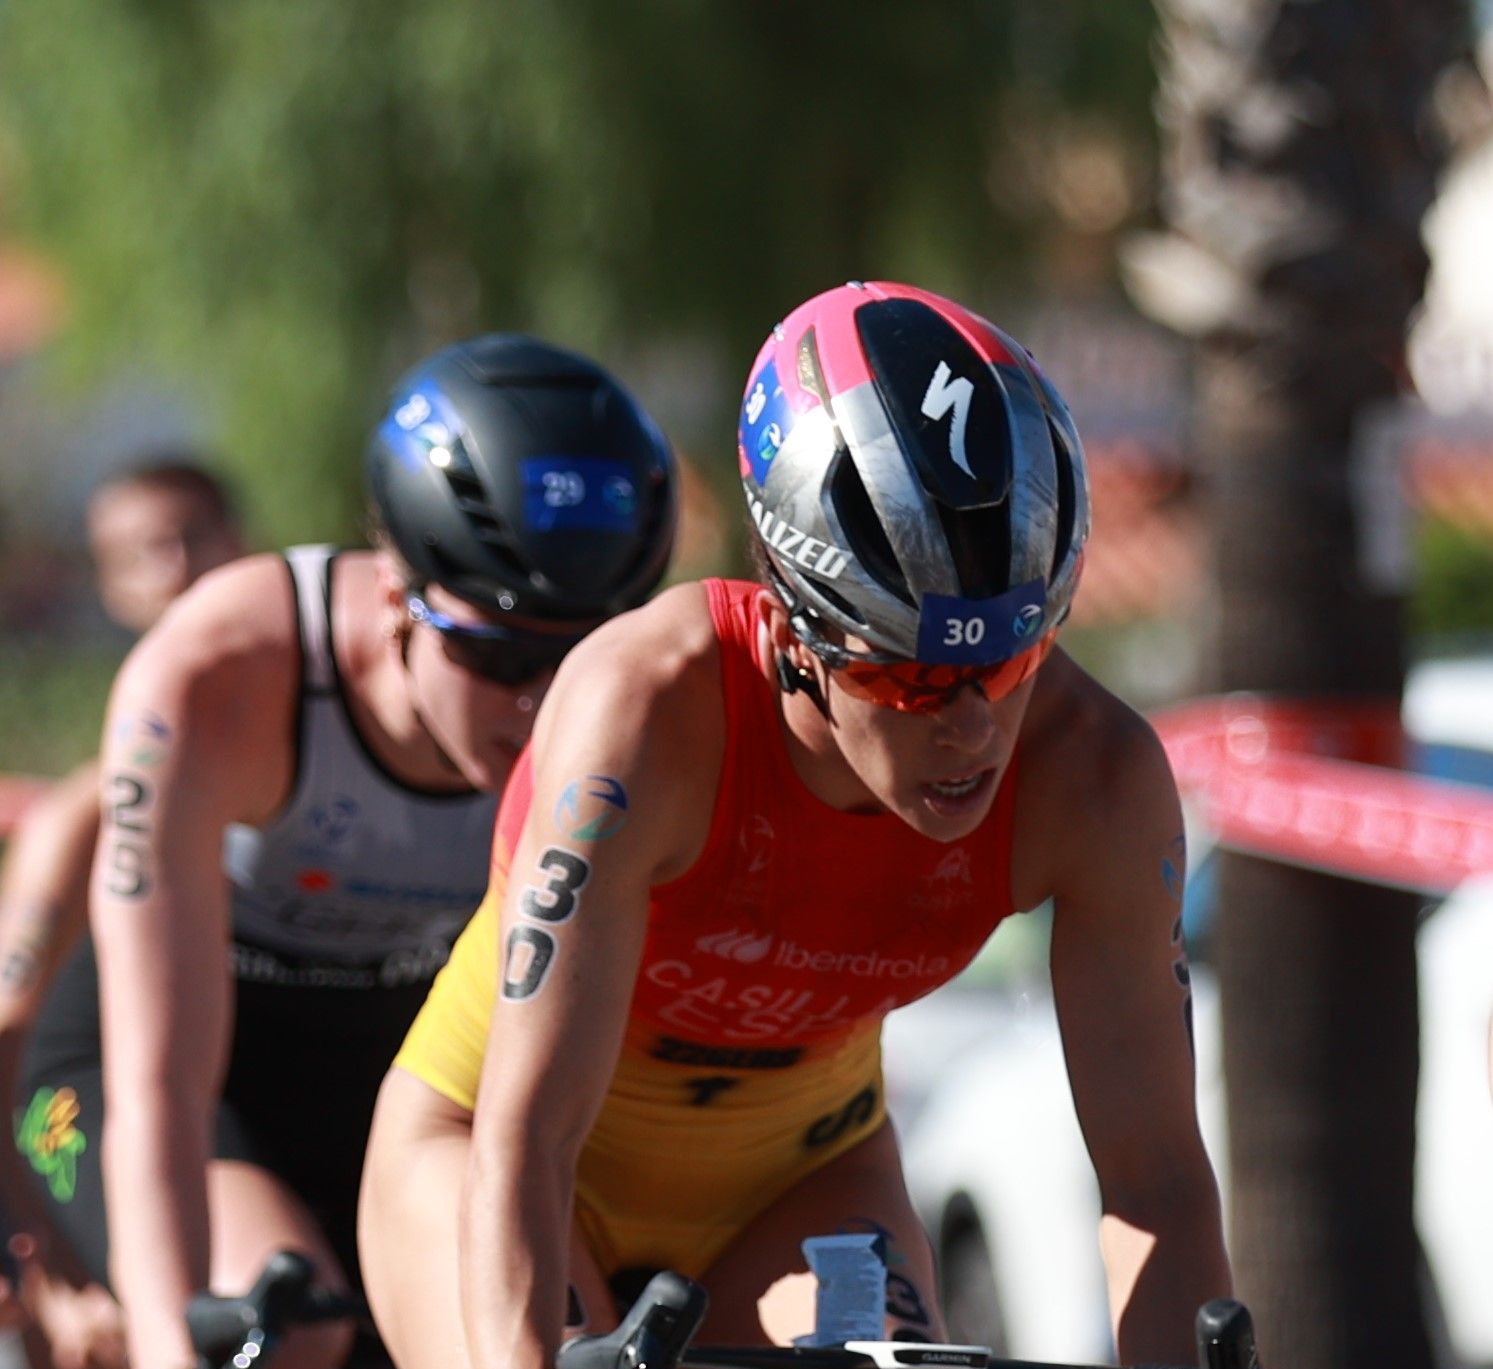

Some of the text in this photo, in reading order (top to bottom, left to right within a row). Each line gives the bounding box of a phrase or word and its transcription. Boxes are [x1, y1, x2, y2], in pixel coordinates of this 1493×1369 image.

[943, 617, 986, 646] 30
[502, 846, 590, 999] 30
[773, 940, 950, 979] Iberdrola
[921, 1352, 971, 1365] GARMIN
